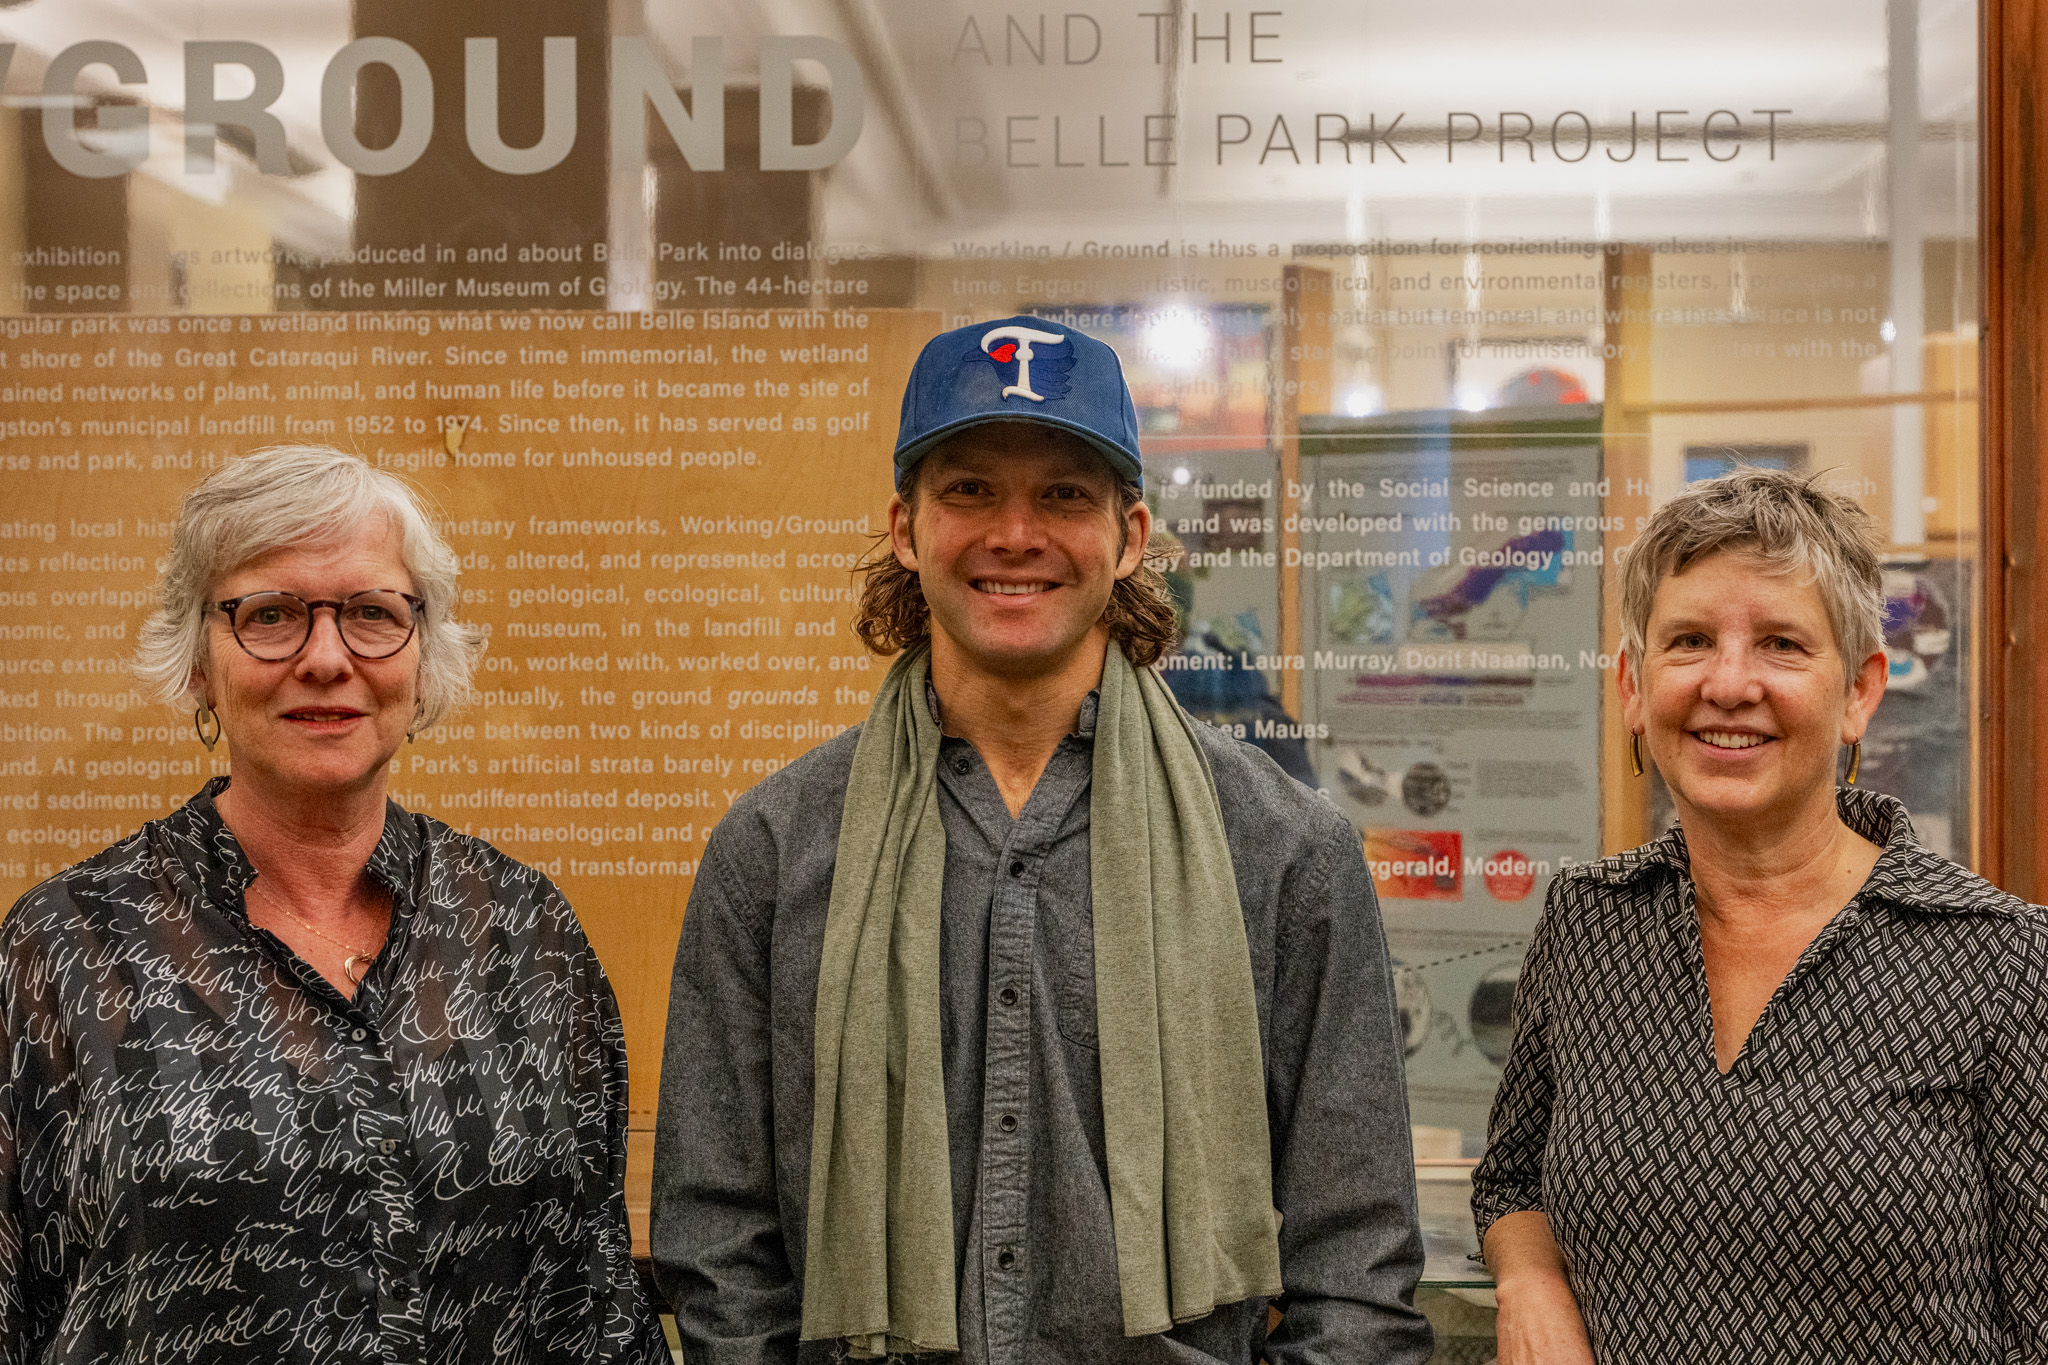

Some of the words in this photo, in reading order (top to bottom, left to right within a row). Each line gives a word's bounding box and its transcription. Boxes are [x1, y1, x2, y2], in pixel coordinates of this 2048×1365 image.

[950, 14, 1101, 66] AND
[1138, 12, 1283, 64] THE
[954, 114, 1177, 168] BELLE
[1217, 112, 1407, 165] PARK
[1447, 109, 1792, 163] PROJECT
[13, 247, 121, 265] exhibition
[319, 245, 426, 268] produced
[466, 244, 507, 262] and
[518, 244, 582, 262] about
[593, 243, 653, 261] Belle
[659, 243, 709, 261] Park
[719, 242, 762, 260] into
[772, 242, 868, 265] dialogue
[952, 240, 1050, 263] Working
[1083, 239, 1170, 257] Ground
[1180, 239, 1198, 257] is
[1209, 239, 1257, 257] thus
[1268, 242, 1279, 256] a
[55, 285, 121, 304] space
[339, 279, 375, 297] the
[384, 279, 447, 297] Miller
[457, 278, 550, 296] Museum
[695, 277, 736, 295] The
[745, 277, 868, 295] 44-hectare
[71, 315, 120, 338] park
[128, 318, 171, 332] was
[178, 318, 232, 332] once
[239, 318, 252, 332] a
[260, 314, 348, 332] wetland
[355, 313, 431, 336] linking
[438, 313, 491, 331] what
[501, 316, 532, 330] we
[539, 316, 585, 330] now
[592, 312, 632, 330] call
[639, 311, 695, 329] Belle
[703, 311, 770, 329] Island
[777, 311, 825, 329] with
[833, 310, 869, 328] the
[1046, 310, 1113, 328] where
[20, 350, 81, 368] shore
[127, 349, 163, 367] the
[175, 349, 236, 367] Great
[249, 348, 358, 371] Cataraqui
[372, 348, 432, 366] River.
[445, 347, 507, 365] Since
[520, 347, 568, 365] time
[581, 346, 719, 368] immemorial,
[731, 346, 767, 364] the
[780, 345, 869, 363] wetland
[1784, 340, 1832, 358] with
[1840, 339, 1877, 357] the
[72, 383, 175, 401] networks
[214, 382, 277, 405] plant,
[285, 382, 364, 403] animal,
[375, 381, 416, 399] and
[425, 381, 500, 399] human
[510, 380, 544, 398] life
[553, 380, 625, 398] before
[657, 379, 745, 397] became
[754, 379, 790, 397] the
[799, 379, 839, 397] site
[81, 417, 189, 440] municipal
[200, 416, 275, 434] landfill
[285, 416, 335, 434] from
[345, 416, 394, 434] 1952
[435, 415, 488, 433] 1974.
[498, 415, 560, 433] Since
[569, 414, 625, 436] then,
[659, 414, 698, 432] has
[707, 414, 782, 432] served
[827, 413, 870, 436] golf
[38, 451, 80, 469] and
[87, 451, 145, 474] park,
[151, 451, 192, 469] and
[200, 450, 214, 468] it
[376, 449, 447, 472] fragile
[455, 449, 516, 467] home
[523, 448, 554, 466] for
[562, 448, 672, 466] unhoused
[680, 447, 762, 470] people.
[1161, 481, 1178, 499] is
[1194, 481, 1272, 499] funded
[1288, 480, 1314, 503] by
[1329, 480, 1365, 498] the
[1380, 480, 1448, 498] Social
[1464, 479, 1554, 497] Science
[1568, 479, 1610, 497] and
[70, 520, 122, 538] local
[529, 517, 667, 539] frameworks,
[680, 517, 869, 540] Working/Ground
[1177, 515, 1220, 533] and
[1230, 519, 1274, 533] was
[1284, 514, 1402, 537] developed
[1413, 514, 1461, 532] with
[1472, 514, 1509, 532] the
[1518, 517, 1625, 536] generous
[39, 553, 145, 571] reflection
[506, 551, 590, 572] altered,
[600, 551, 641, 569] and
[650, 550, 786, 573] represented
[1189, 549, 1231, 567] and
[1241, 549, 1276, 567] the
[1286, 548, 1420, 571] Department
[1429, 548, 1450, 566] of
[1459, 548, 1553, 571] Geology
[1561, 547, 1603, 565] and
[508, 585, 630, 608] geological,
[644, 584, 765, 607] ecological,
[84, 621, 126, 639] and
[506, 623, 607, 641] museum,
[655, 619, 691, 637] the
[704, 619, 781, 637] landfill
[794, 618, 836, 636] and
[527, 653, 608, 671] worked
[617, 653, 670, 675] with,
[678, 653, 759, 671] worked
[767, 657, 820, 674] over,
[828, 652, 871, 670] and
[1242, 652, 1305, 670] Laura
[1314, 652, 1398, 675] Murray,
[1407, 651, 1460, 669] Dorit
[1471, 651, 1571, 672] Naaman,
[580, 687, 616, 705] the
[632, 687, 712, 710] ground
[728, 686, 818, 709] grounds
[835, 686, 871, 704] the
[83, 723, 124, 741] The
[485, 721, 580, 739] between
[590, 723, 631, 739] two
[640, 721, 700, 739] kinds
[709, 721, 731, 739] of
[1255, 721, 1330, 739] Mauas
[52, 757, 75, 775] At
[85, 757, 200, 780] geological
[488, 755, 580, 773] artificial
[590, 757, 654, 773] strata
[664, 755, 734, 778] barely
[47, 791, 162, 809] sediments
[442, 790, 618, 808] undifferentiated
[625, 789, 715, 812] deposit.
[7, 825, 121, 848] ecological
[479, 823, 643, 846] archaeological
[652, 823, 692, 841] and
[1464, 857, 1550, 875] Modern
